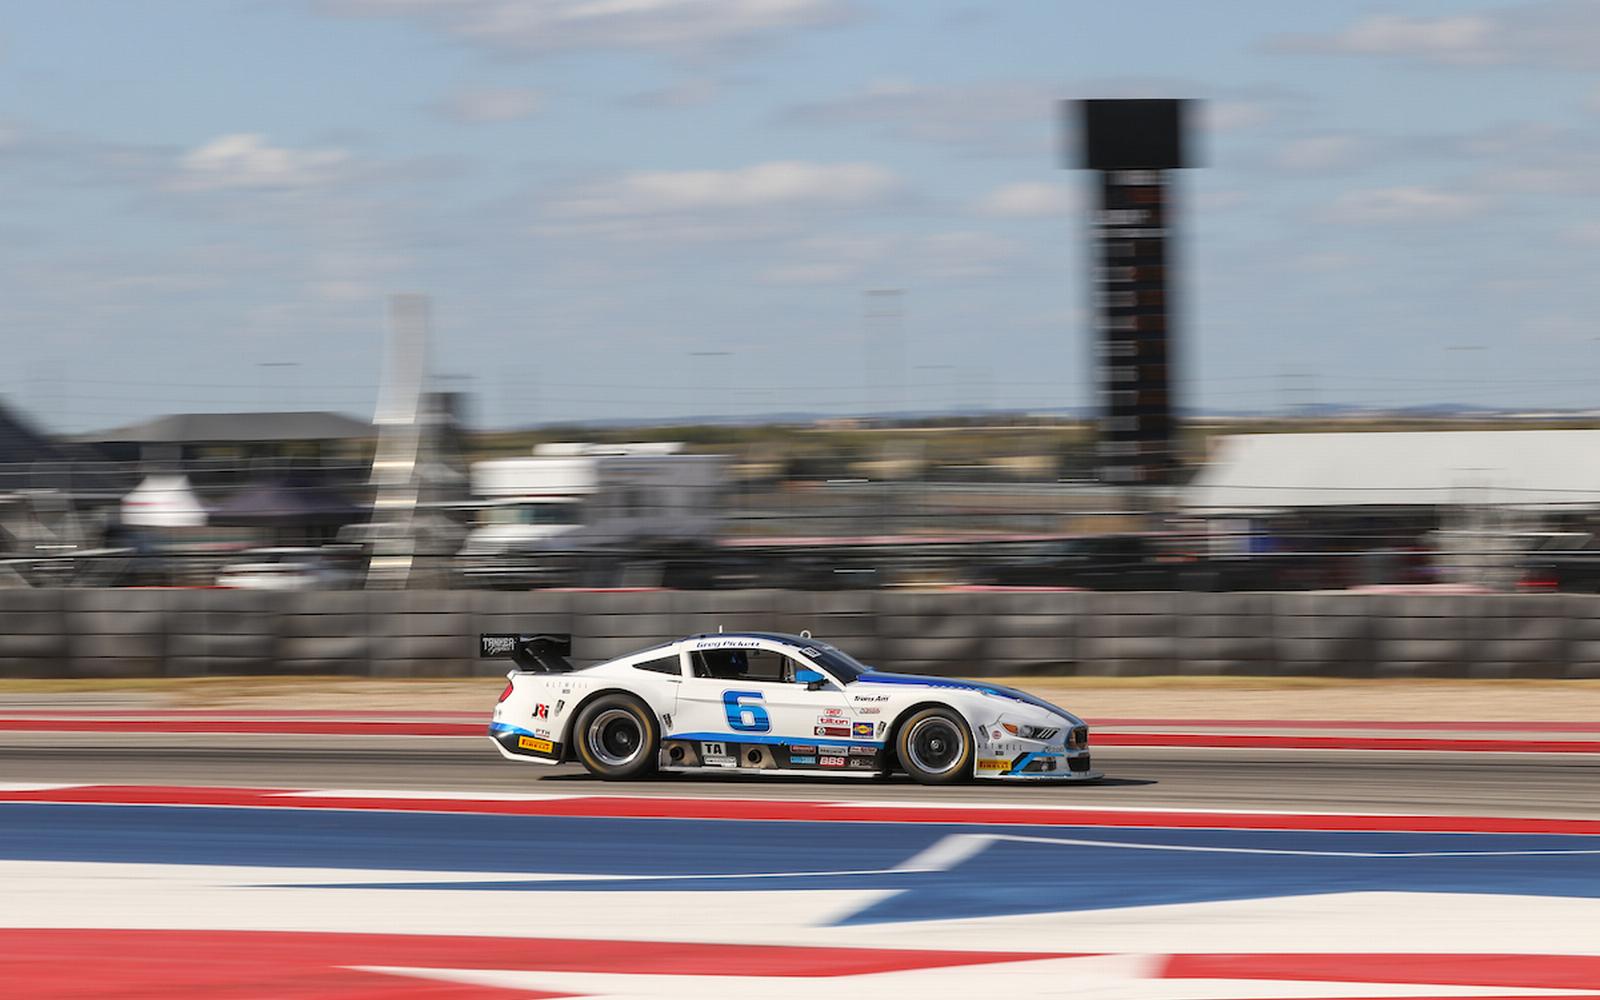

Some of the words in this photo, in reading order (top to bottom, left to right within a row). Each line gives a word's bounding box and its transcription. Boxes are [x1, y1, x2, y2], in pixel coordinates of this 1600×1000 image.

[722, 690, 771, 732] 6
[521, 738, 551, 751] PIRELLI
[704, 743, 723, 754] TA
[819, 756, 845, 766] BBS
